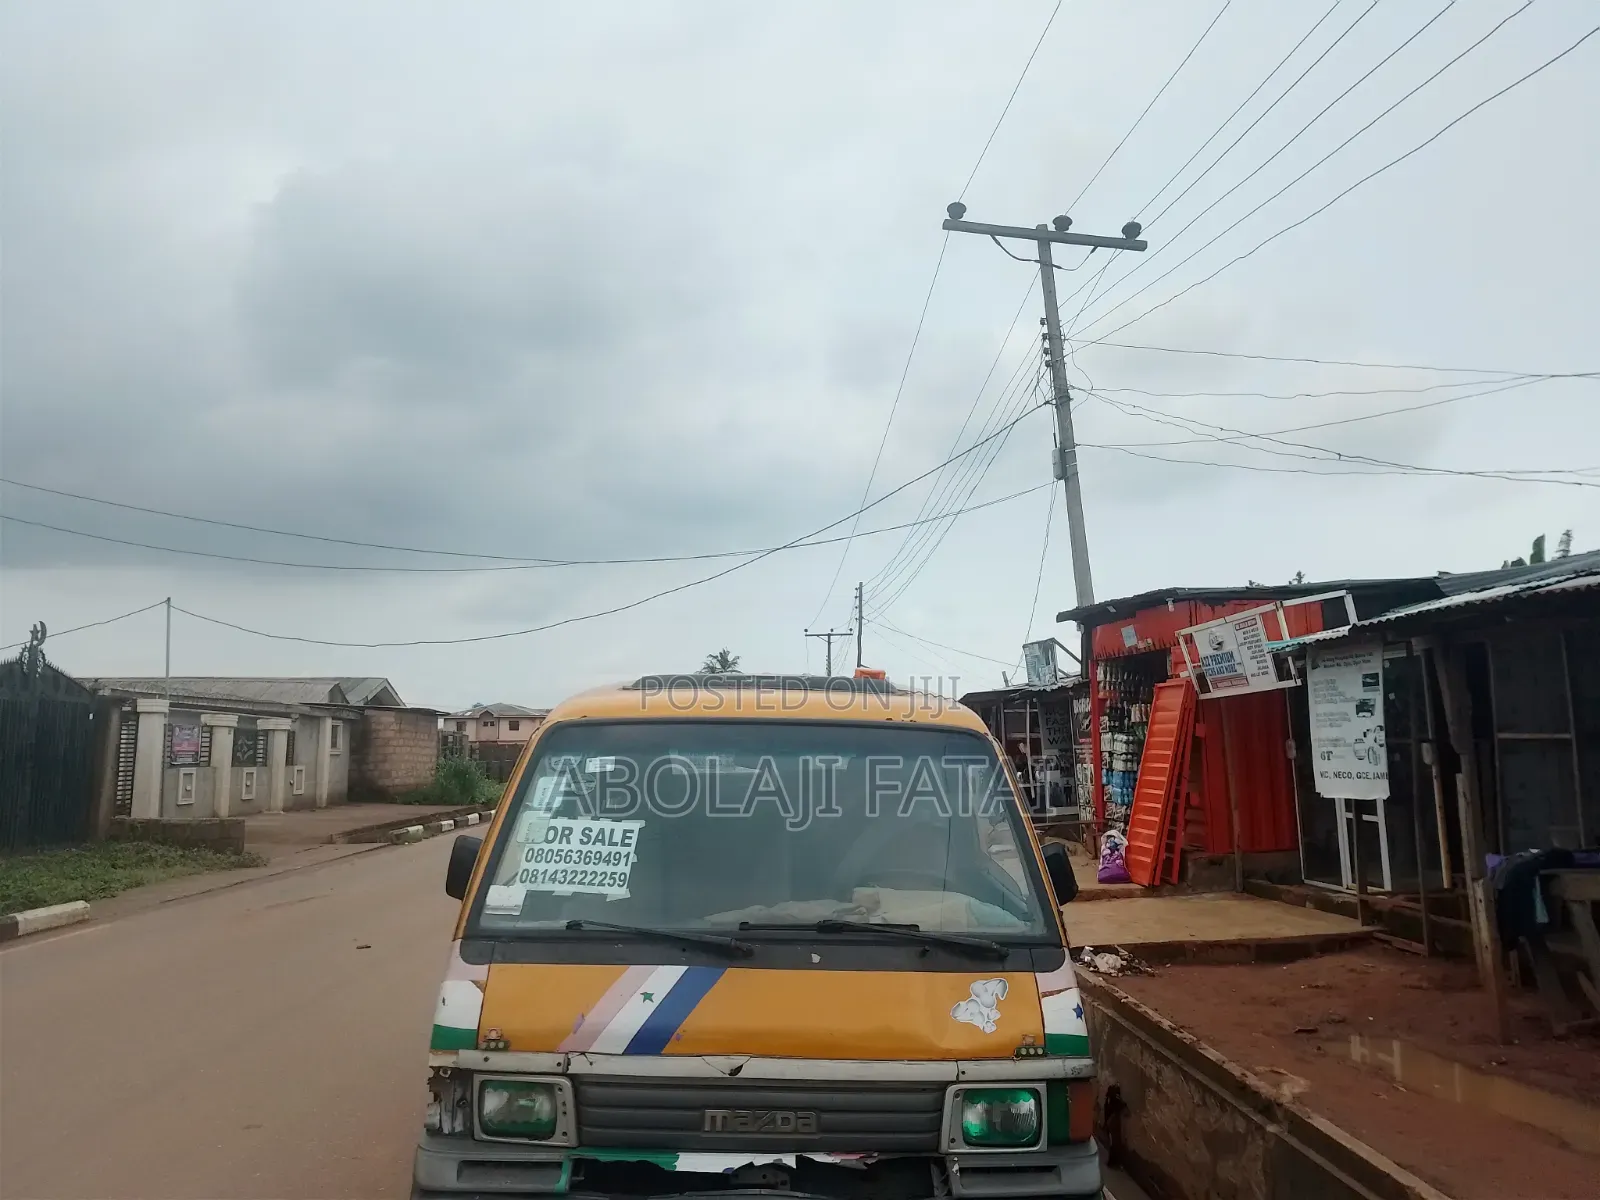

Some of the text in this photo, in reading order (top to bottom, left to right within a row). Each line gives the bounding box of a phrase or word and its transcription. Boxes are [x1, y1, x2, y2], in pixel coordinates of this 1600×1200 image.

[1210, 651, 1236, 667] PREMIUM
[1216, 665, 1225, 675] AND
[579, 827, 635, 848] SALE
[524, 847, 632, 867] 08056369491
[519, 868, 628, 888] 08143222259
